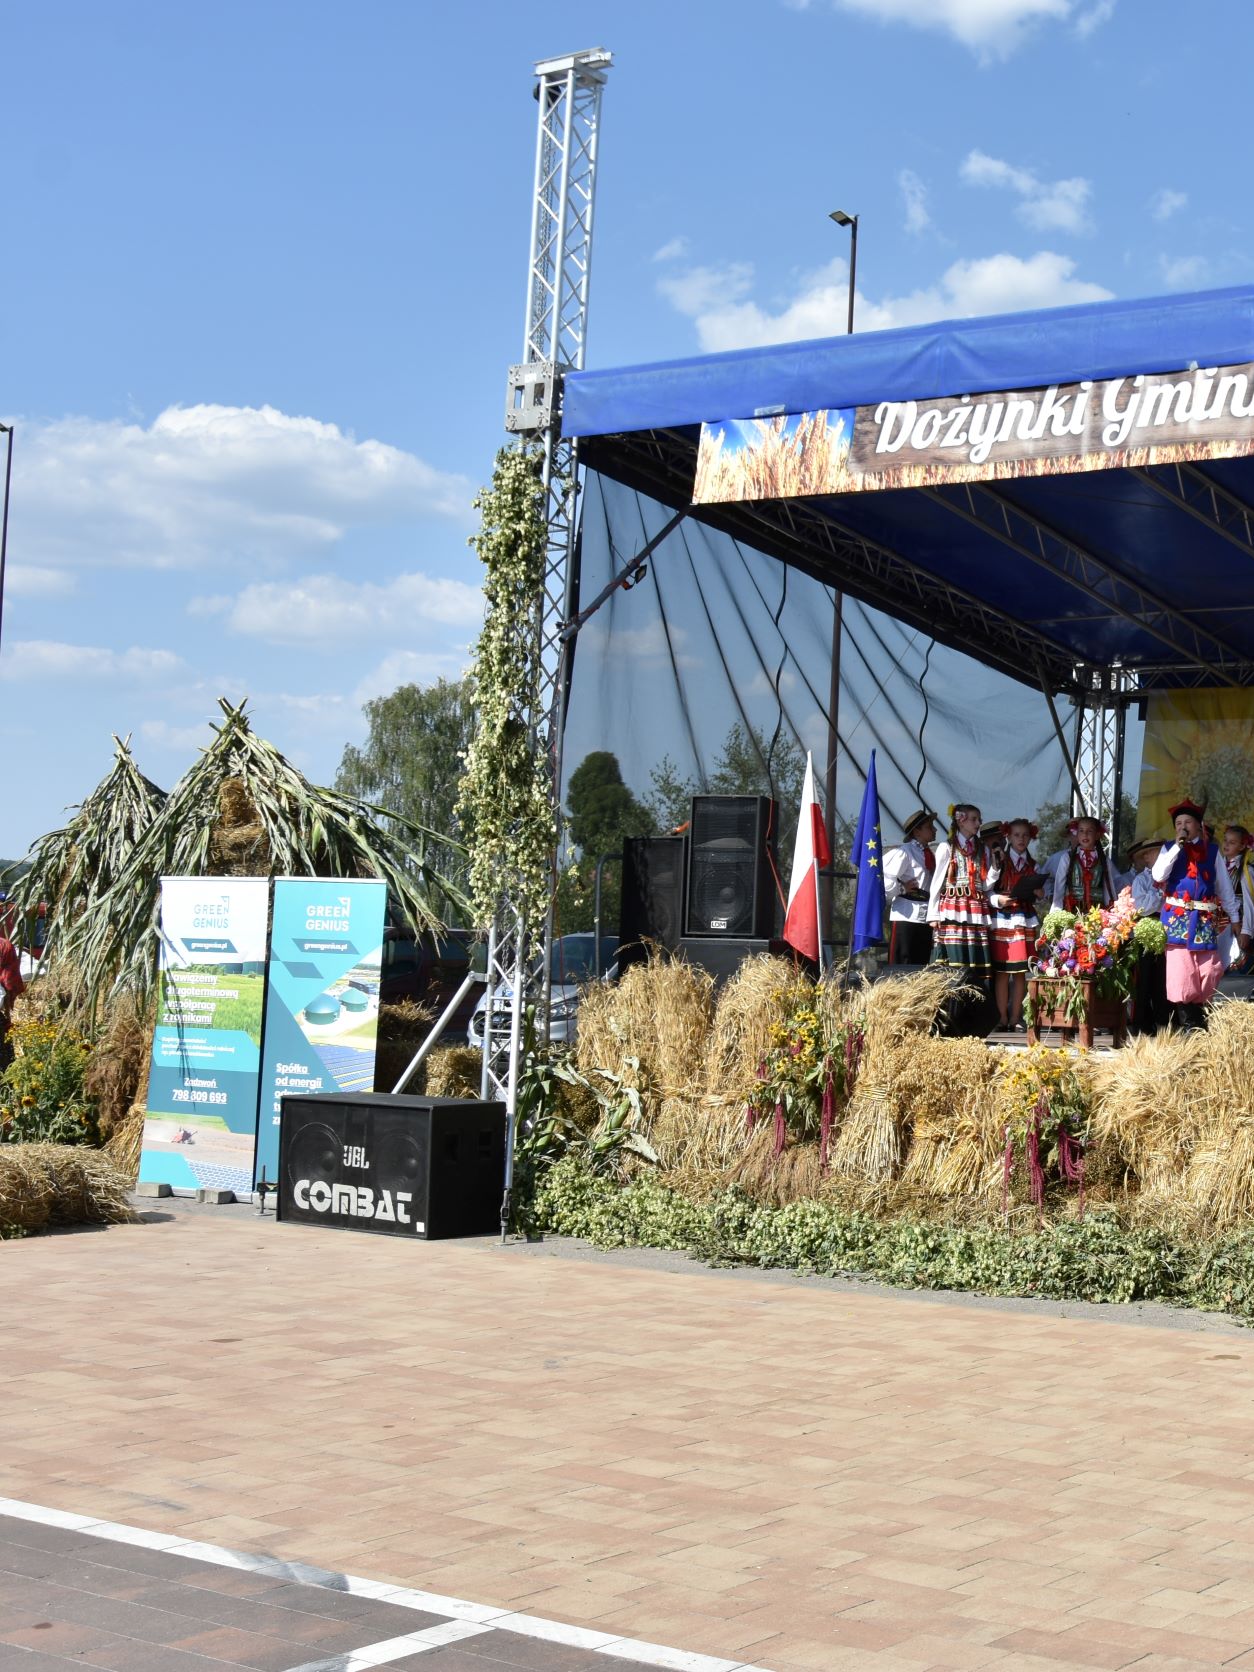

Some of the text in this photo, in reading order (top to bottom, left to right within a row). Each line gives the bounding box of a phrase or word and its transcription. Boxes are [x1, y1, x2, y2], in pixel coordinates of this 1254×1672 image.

[874, 381, 1093, 464] Dożynki
[194, 901, 230, 915] GREEN
[306, 902, 351, 917] GREEN
[193, 917, 229, 928] GENIUS
[305, 919, 350, 931] GENIUS
[276, 1063, 308, 1075] Spółka
[275, 1076, 322, 1090] od energii
[209, 1092, 227, 1103] 693
[343, 1145, 370, 1169] JBL
[294, 1179, 413, 1224] COMBAT
